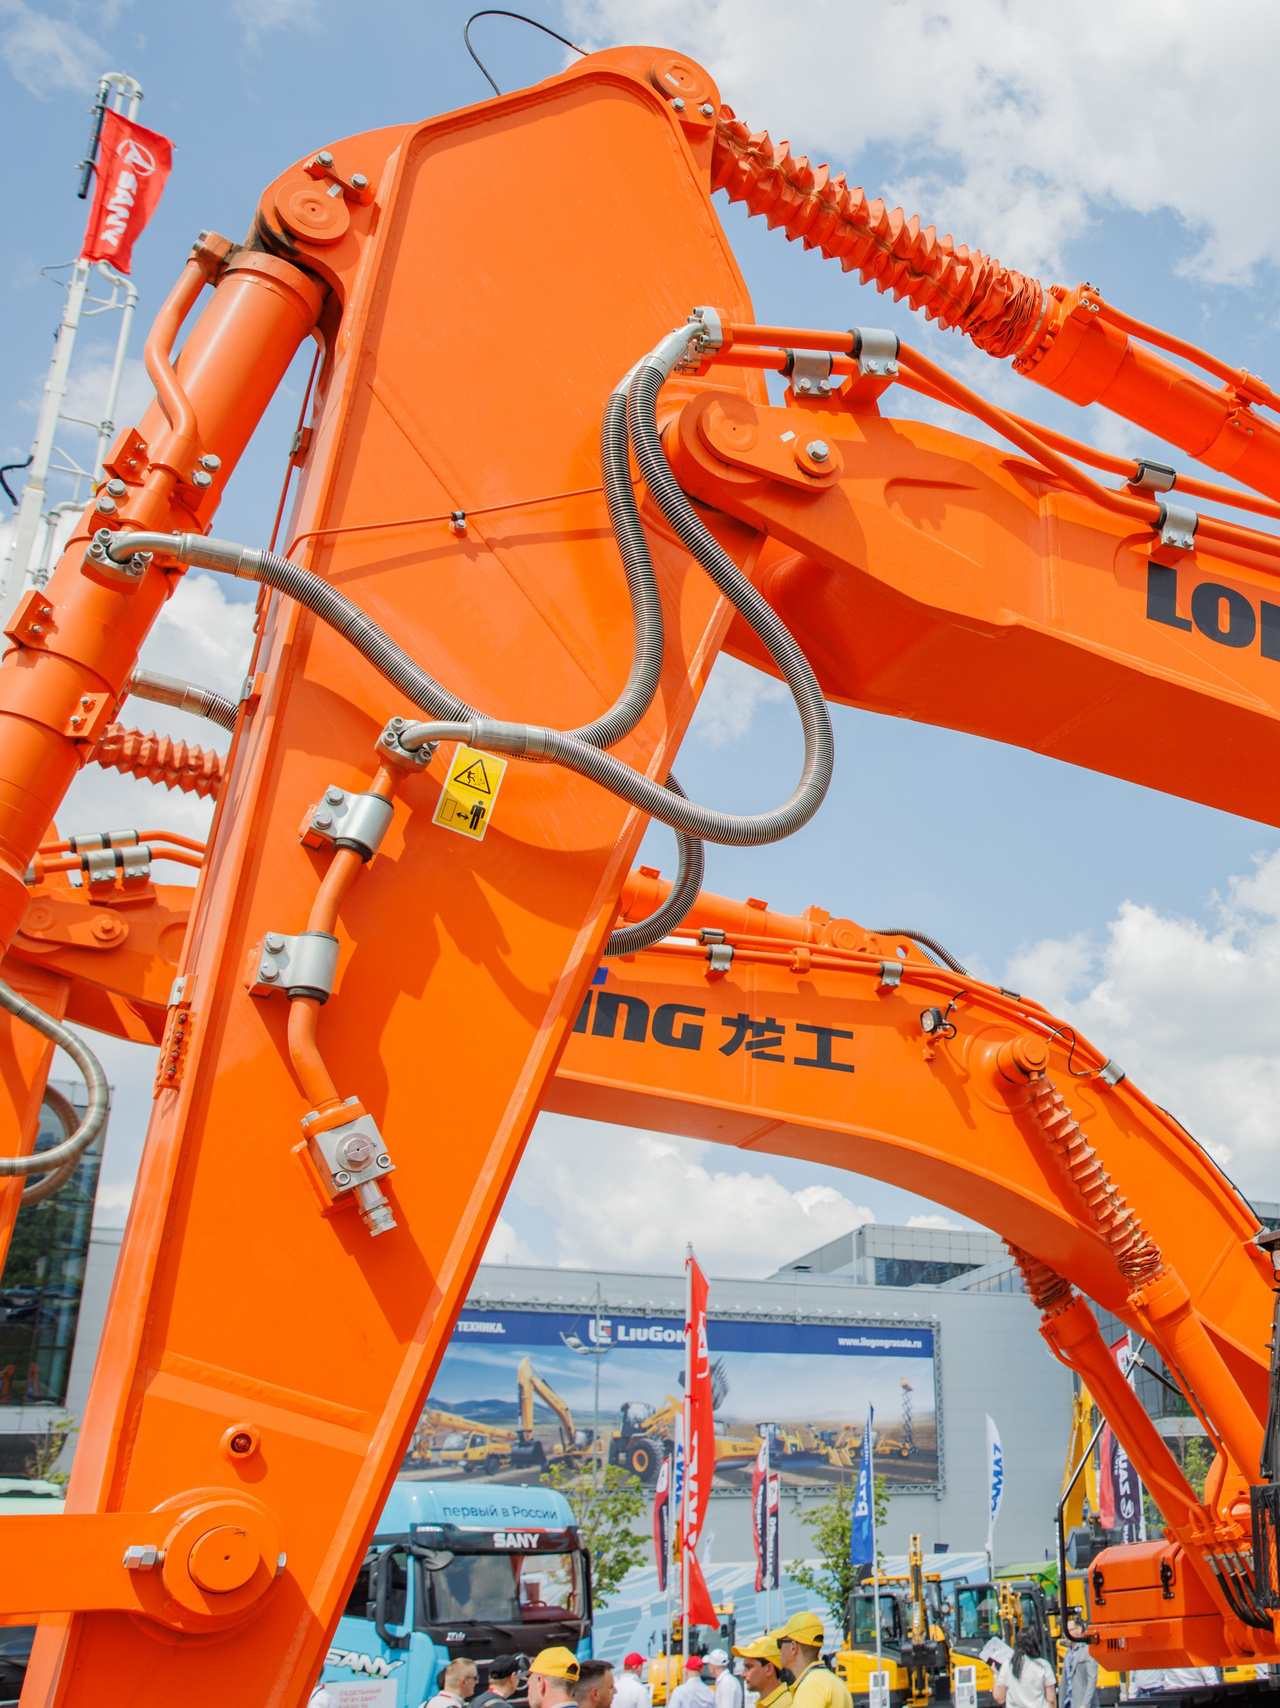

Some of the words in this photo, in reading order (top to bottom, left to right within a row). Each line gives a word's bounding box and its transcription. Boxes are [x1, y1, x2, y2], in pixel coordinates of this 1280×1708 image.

[100, 170, 138, 247] SANY
[719, 1012, 855, 1073] 龙工
[457, 1320, 506, 1334] ТЕХНИКА.
[443, 1505, 499, 1518] первый
[502, 1508, 510, 1517] в
[512, 1506, 558, 1519] России
[493, 1533, 540, 1548] SANY
